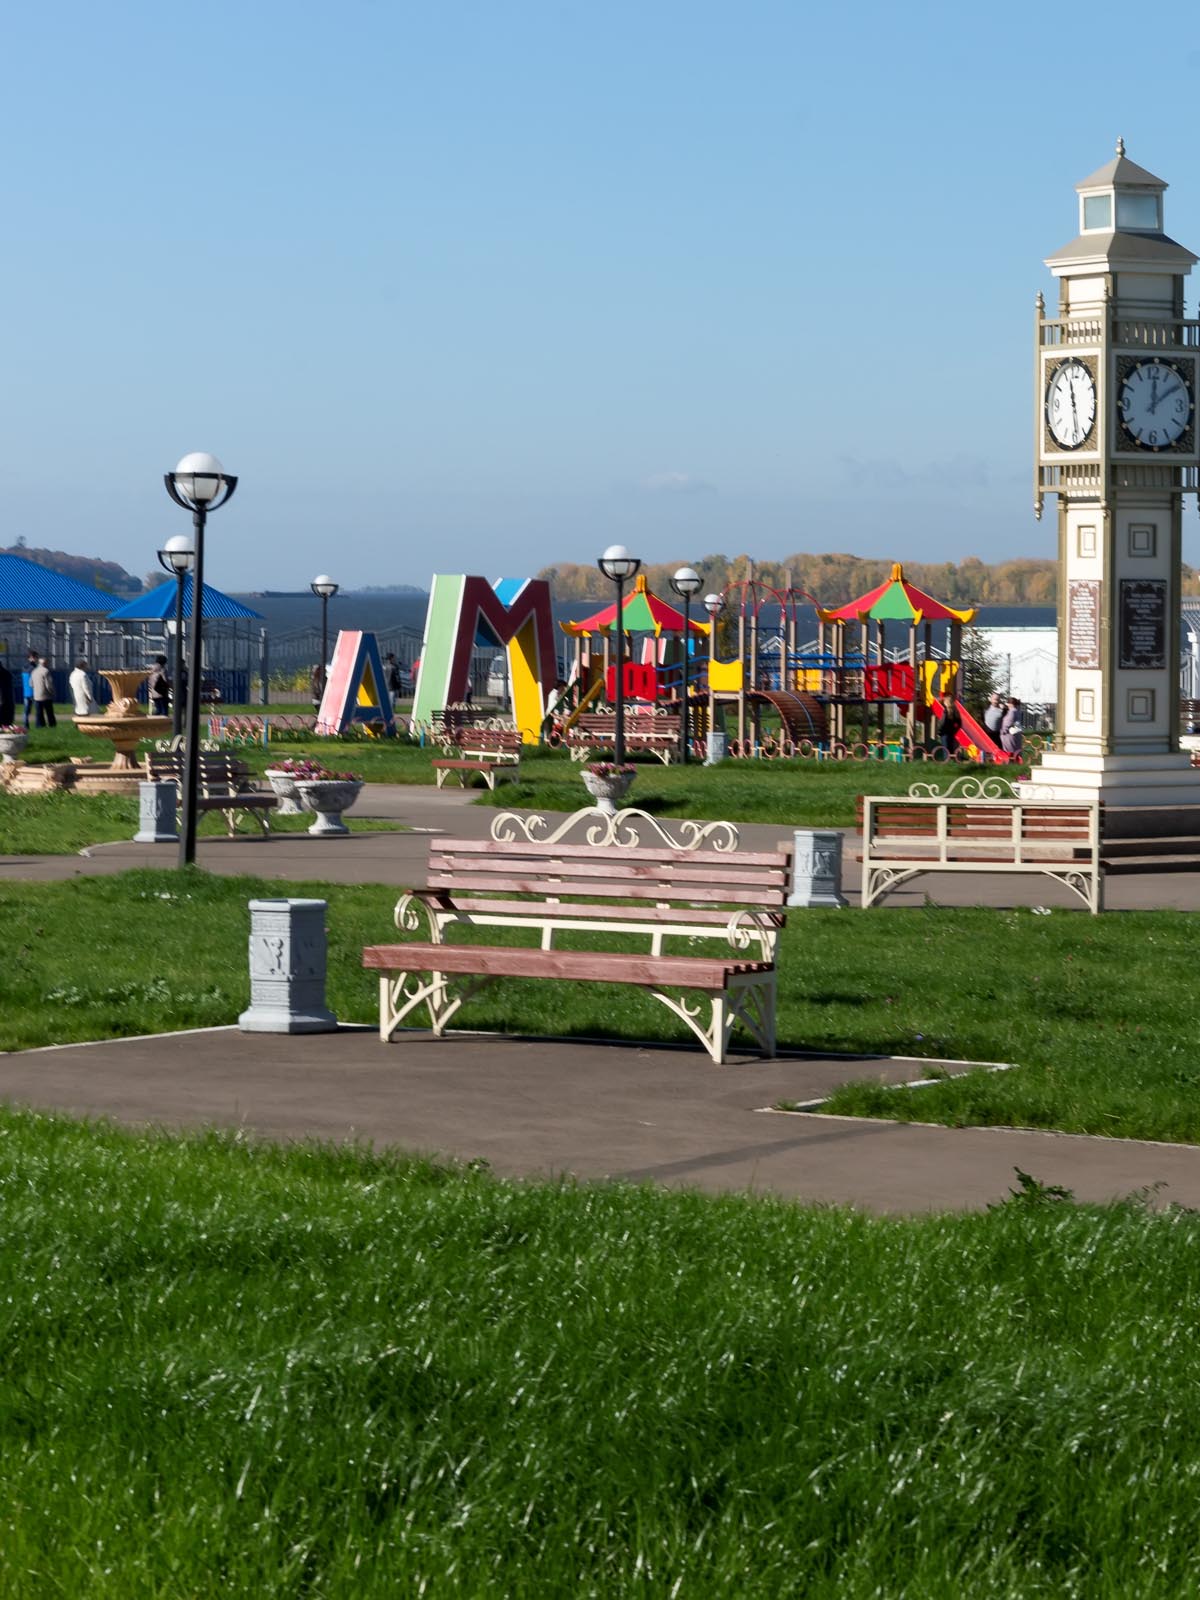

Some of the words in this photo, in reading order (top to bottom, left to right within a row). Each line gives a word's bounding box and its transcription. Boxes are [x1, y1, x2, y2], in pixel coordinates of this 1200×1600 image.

[1147, 366, 1160, 380] 12
[1122, 397, 1131, 411] 9
[1175, 399, 1184, 413] 3
[1149, 430, 1157, 444] 6
